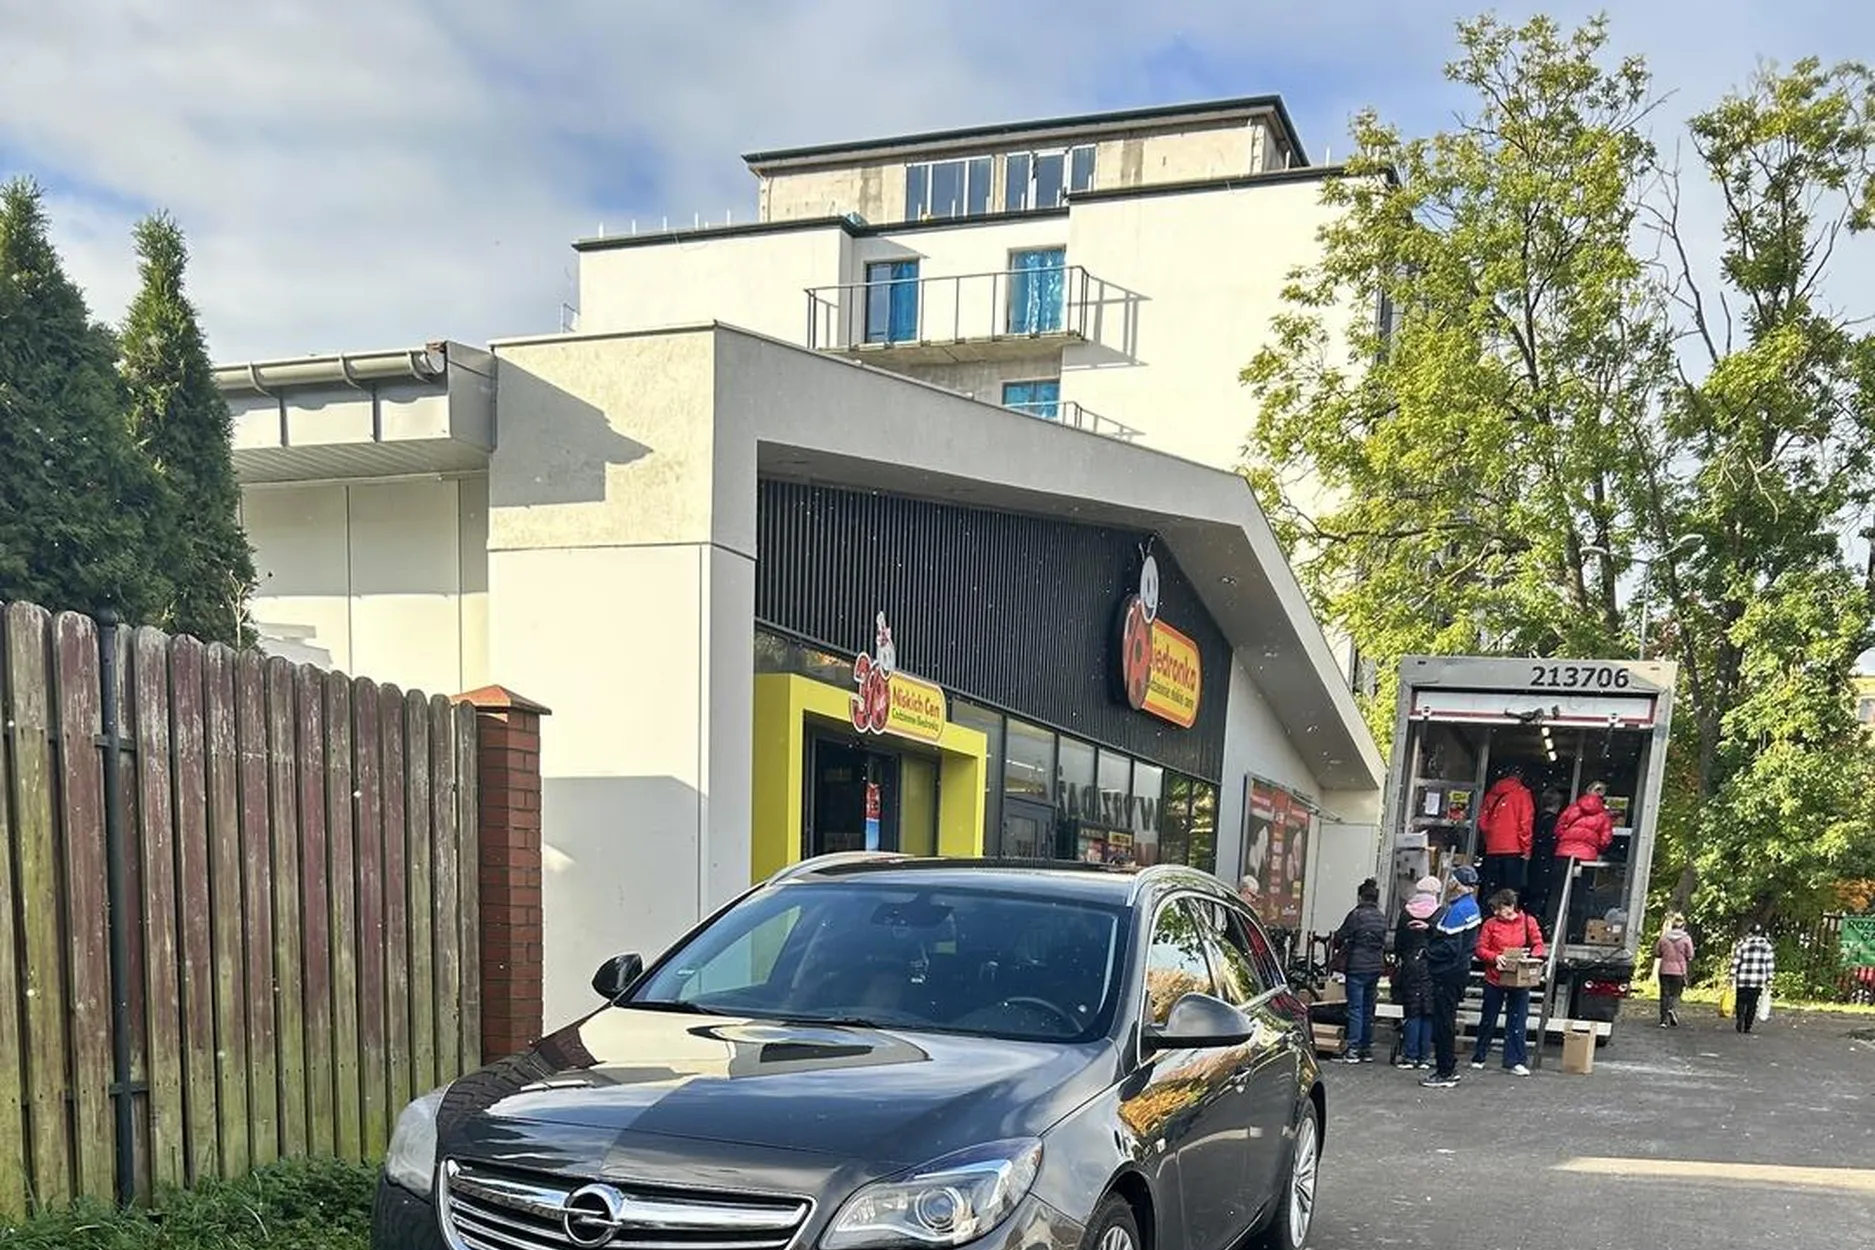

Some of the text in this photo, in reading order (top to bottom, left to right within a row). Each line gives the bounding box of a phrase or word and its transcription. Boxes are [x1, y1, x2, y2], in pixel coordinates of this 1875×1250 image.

[1151, 636, 1196, 692] iedronka
[1530, 666, 1629, 688] 213706
[925, 696, 940, 720] Cen
